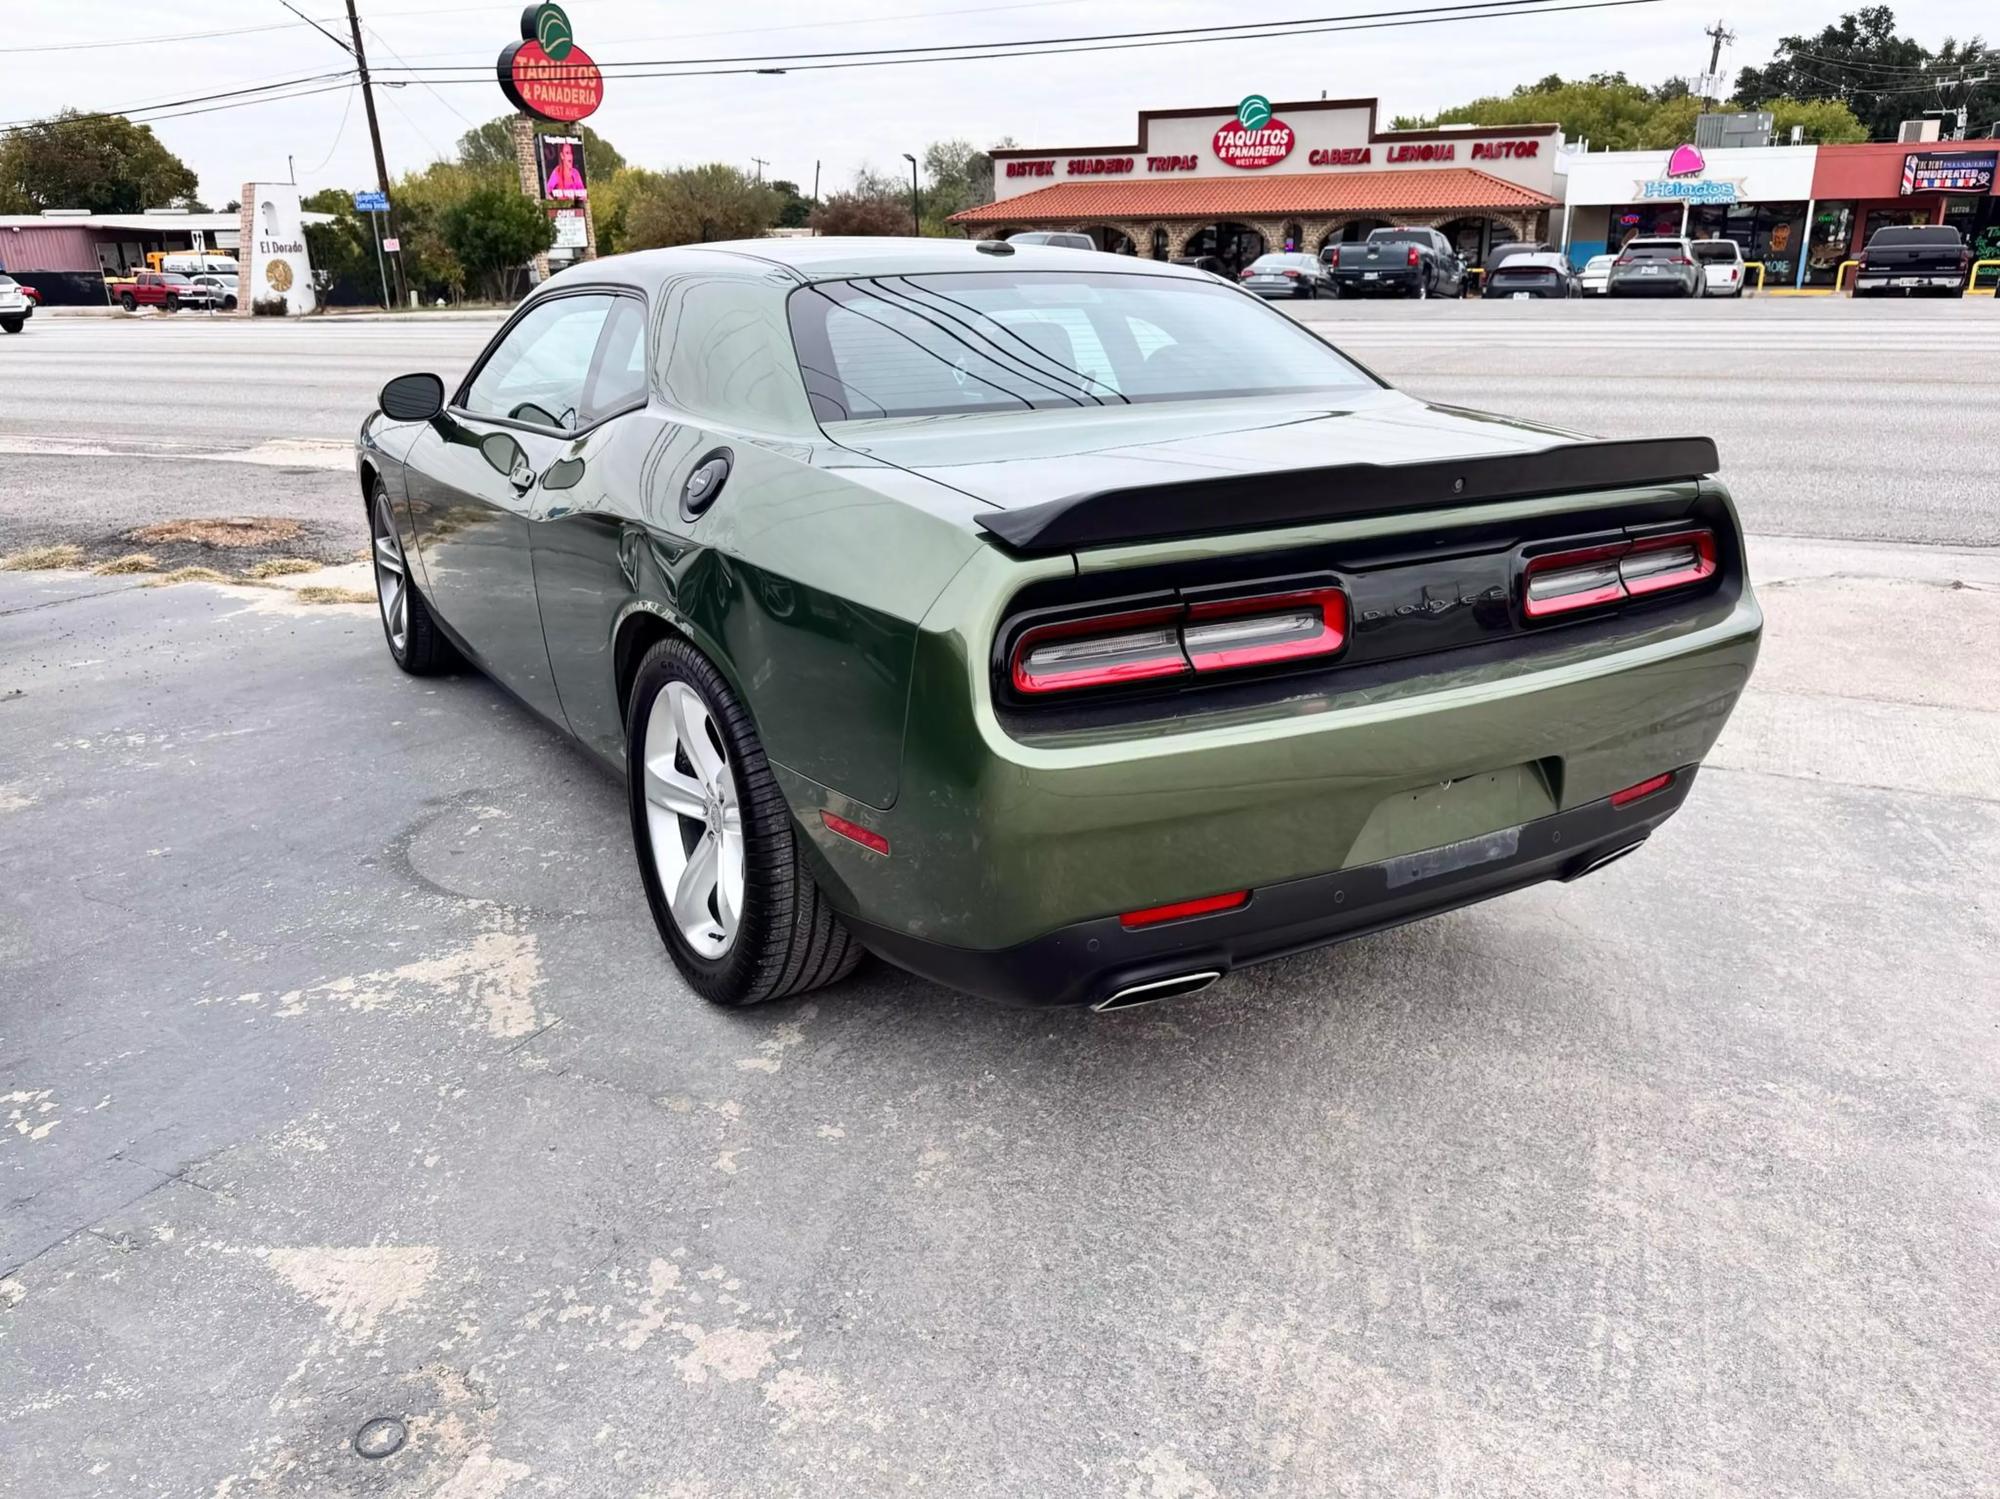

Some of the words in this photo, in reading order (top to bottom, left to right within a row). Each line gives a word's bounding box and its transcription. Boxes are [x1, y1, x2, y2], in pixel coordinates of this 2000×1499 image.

[515, 56, 597, 87] TAQUITOS
[523, 82, 531, 100] &
[534, 84, 597, 105] PANADERIA
[544, 105, 563, 117] WEST
[1218, 128, 1290, 147] TAQUITOS
[1219, 147, 1227, 158] &
[1228, 145, 1286, 158] PANADERIA
[1308, 148, 1371, 166] CABEZA
[1387, 144, 1455, 163] LENGUA
[1471, 141, 1540, 160] PASTOR
[1006, 161, 1056, 178] BISTEK
[1067, 158, 1135, 176] SUADERO
[1147, 155, 1198, 173] TRIPAS
[1235, 158, 1253, 166] WEST
[1916, 169, 1979, 179] UNDEFEATED
[1644, 180, 1735, 198] Helados
[260, 240, 270, 254] El
[272, 240, 303, 254] Dorado
